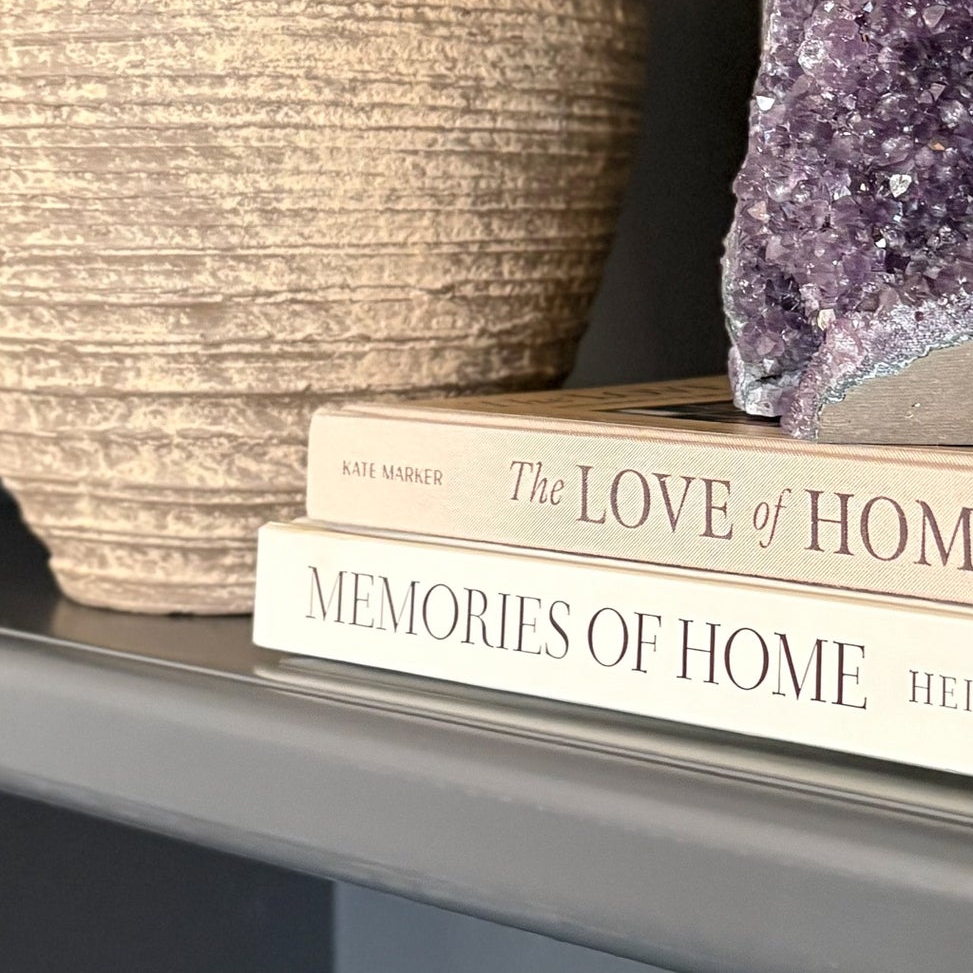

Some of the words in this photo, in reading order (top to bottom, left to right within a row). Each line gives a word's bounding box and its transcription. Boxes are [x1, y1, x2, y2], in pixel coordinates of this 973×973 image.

[342, 460, 377, 479] KATE
[382, 464, 443, 486] MARKER
[510, 461, 565, 506] The
[575, 464, 733, 540] LOVE
[752, 488, 792, 548] of
[305, 565, 570, 659] MEMORIES
[587, 607, 662, 673] OF
[676, 618, 867, 710] HOME
